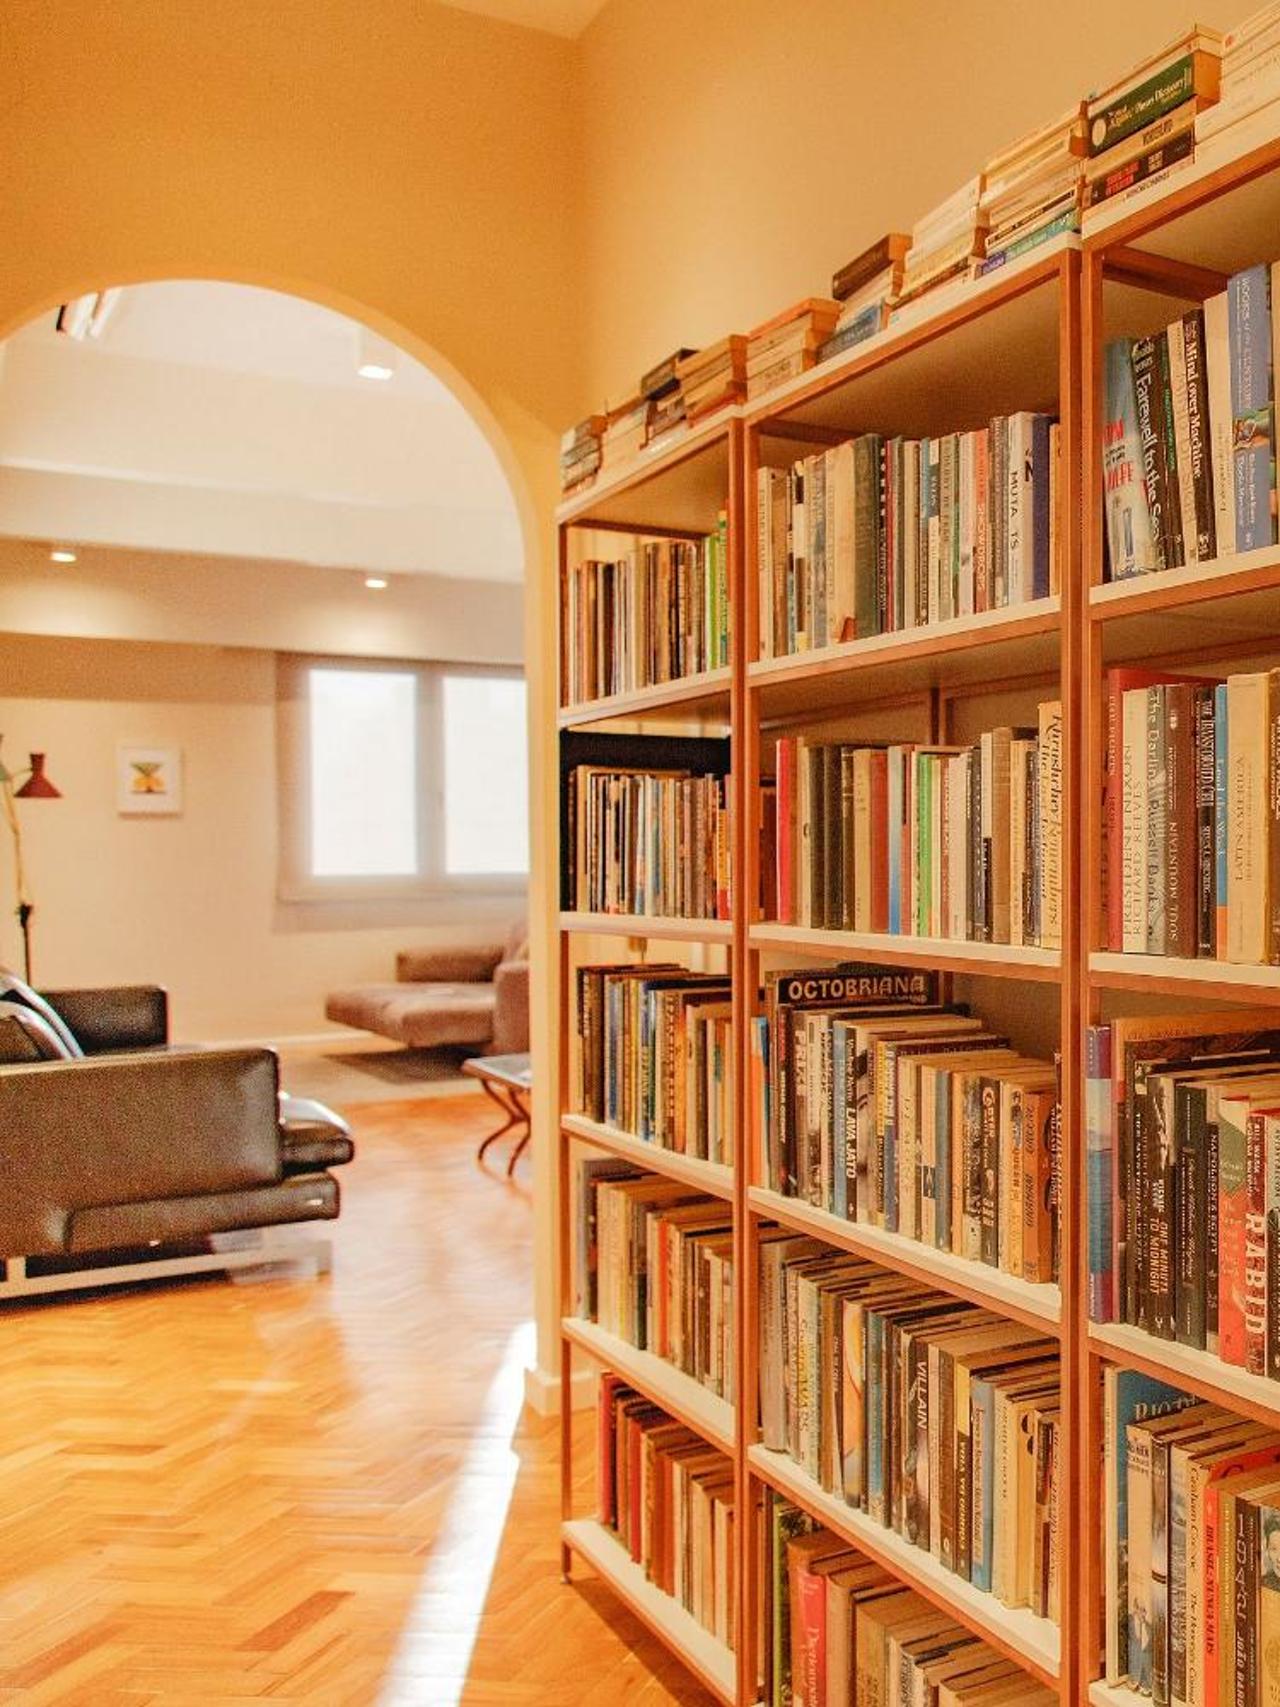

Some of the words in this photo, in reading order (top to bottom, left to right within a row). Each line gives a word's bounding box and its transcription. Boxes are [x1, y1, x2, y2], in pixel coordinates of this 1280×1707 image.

[1185, 342, 1199, 381] Mind
[1188, 383, 1199, 413] over
[1189, 413, 1203, 478] Machine
[1046, 715, 1062, 817] Khrushchev
[1169, 821, 1178, 899] MOUNTAIN
[1169, 904, 1178, 941] SOUL
[788, 975, 925, 999] OCTOBRIANA
[846, 1106, 857, 1141] LAVA
[846, 1142, 857, 1179] JATO
[1210, 1133, 1218, 1212] NAPOLEON'S
[1150, 1217, 1159, 1232] TO
[1158, 1221, 1168, 1246] ONE
[1210, 1214, 1218, 1255] EGYPT
[1149, 1234, 1160, 1295] MIDNIGHT
[1159, 1248, 1168, 1294] MINUTE
[1245, 1211, 1266, 1336] RABID
[916, 1360, 928, 1430] VILLAIN
